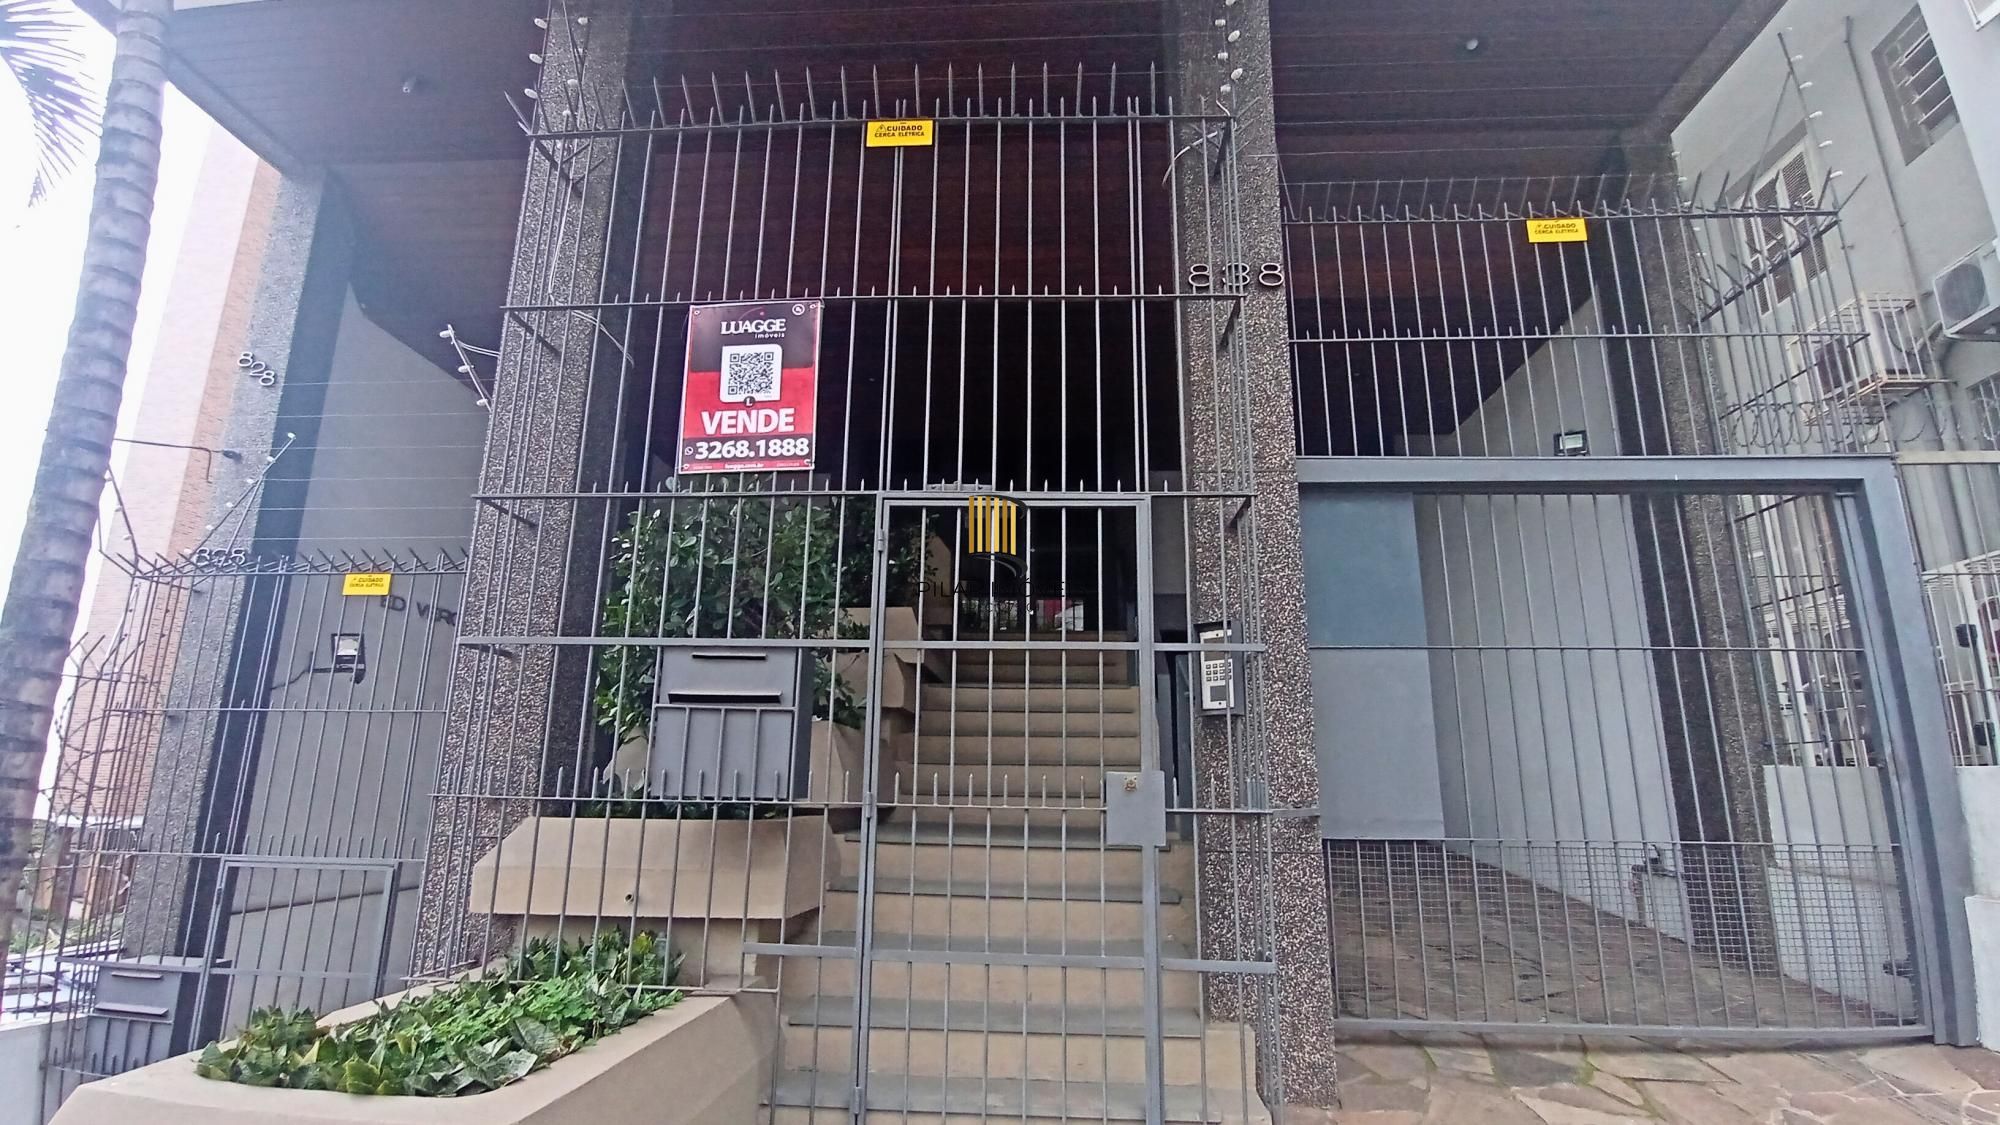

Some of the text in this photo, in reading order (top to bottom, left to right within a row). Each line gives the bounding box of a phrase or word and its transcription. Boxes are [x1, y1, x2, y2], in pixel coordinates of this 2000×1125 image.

[720, 318, 787, 335] LUAGGE
[237, 351, 275, 386] 828
[701, 407, 795, 435] VENDE
[695, 438, 810, 460] 3268.1888
